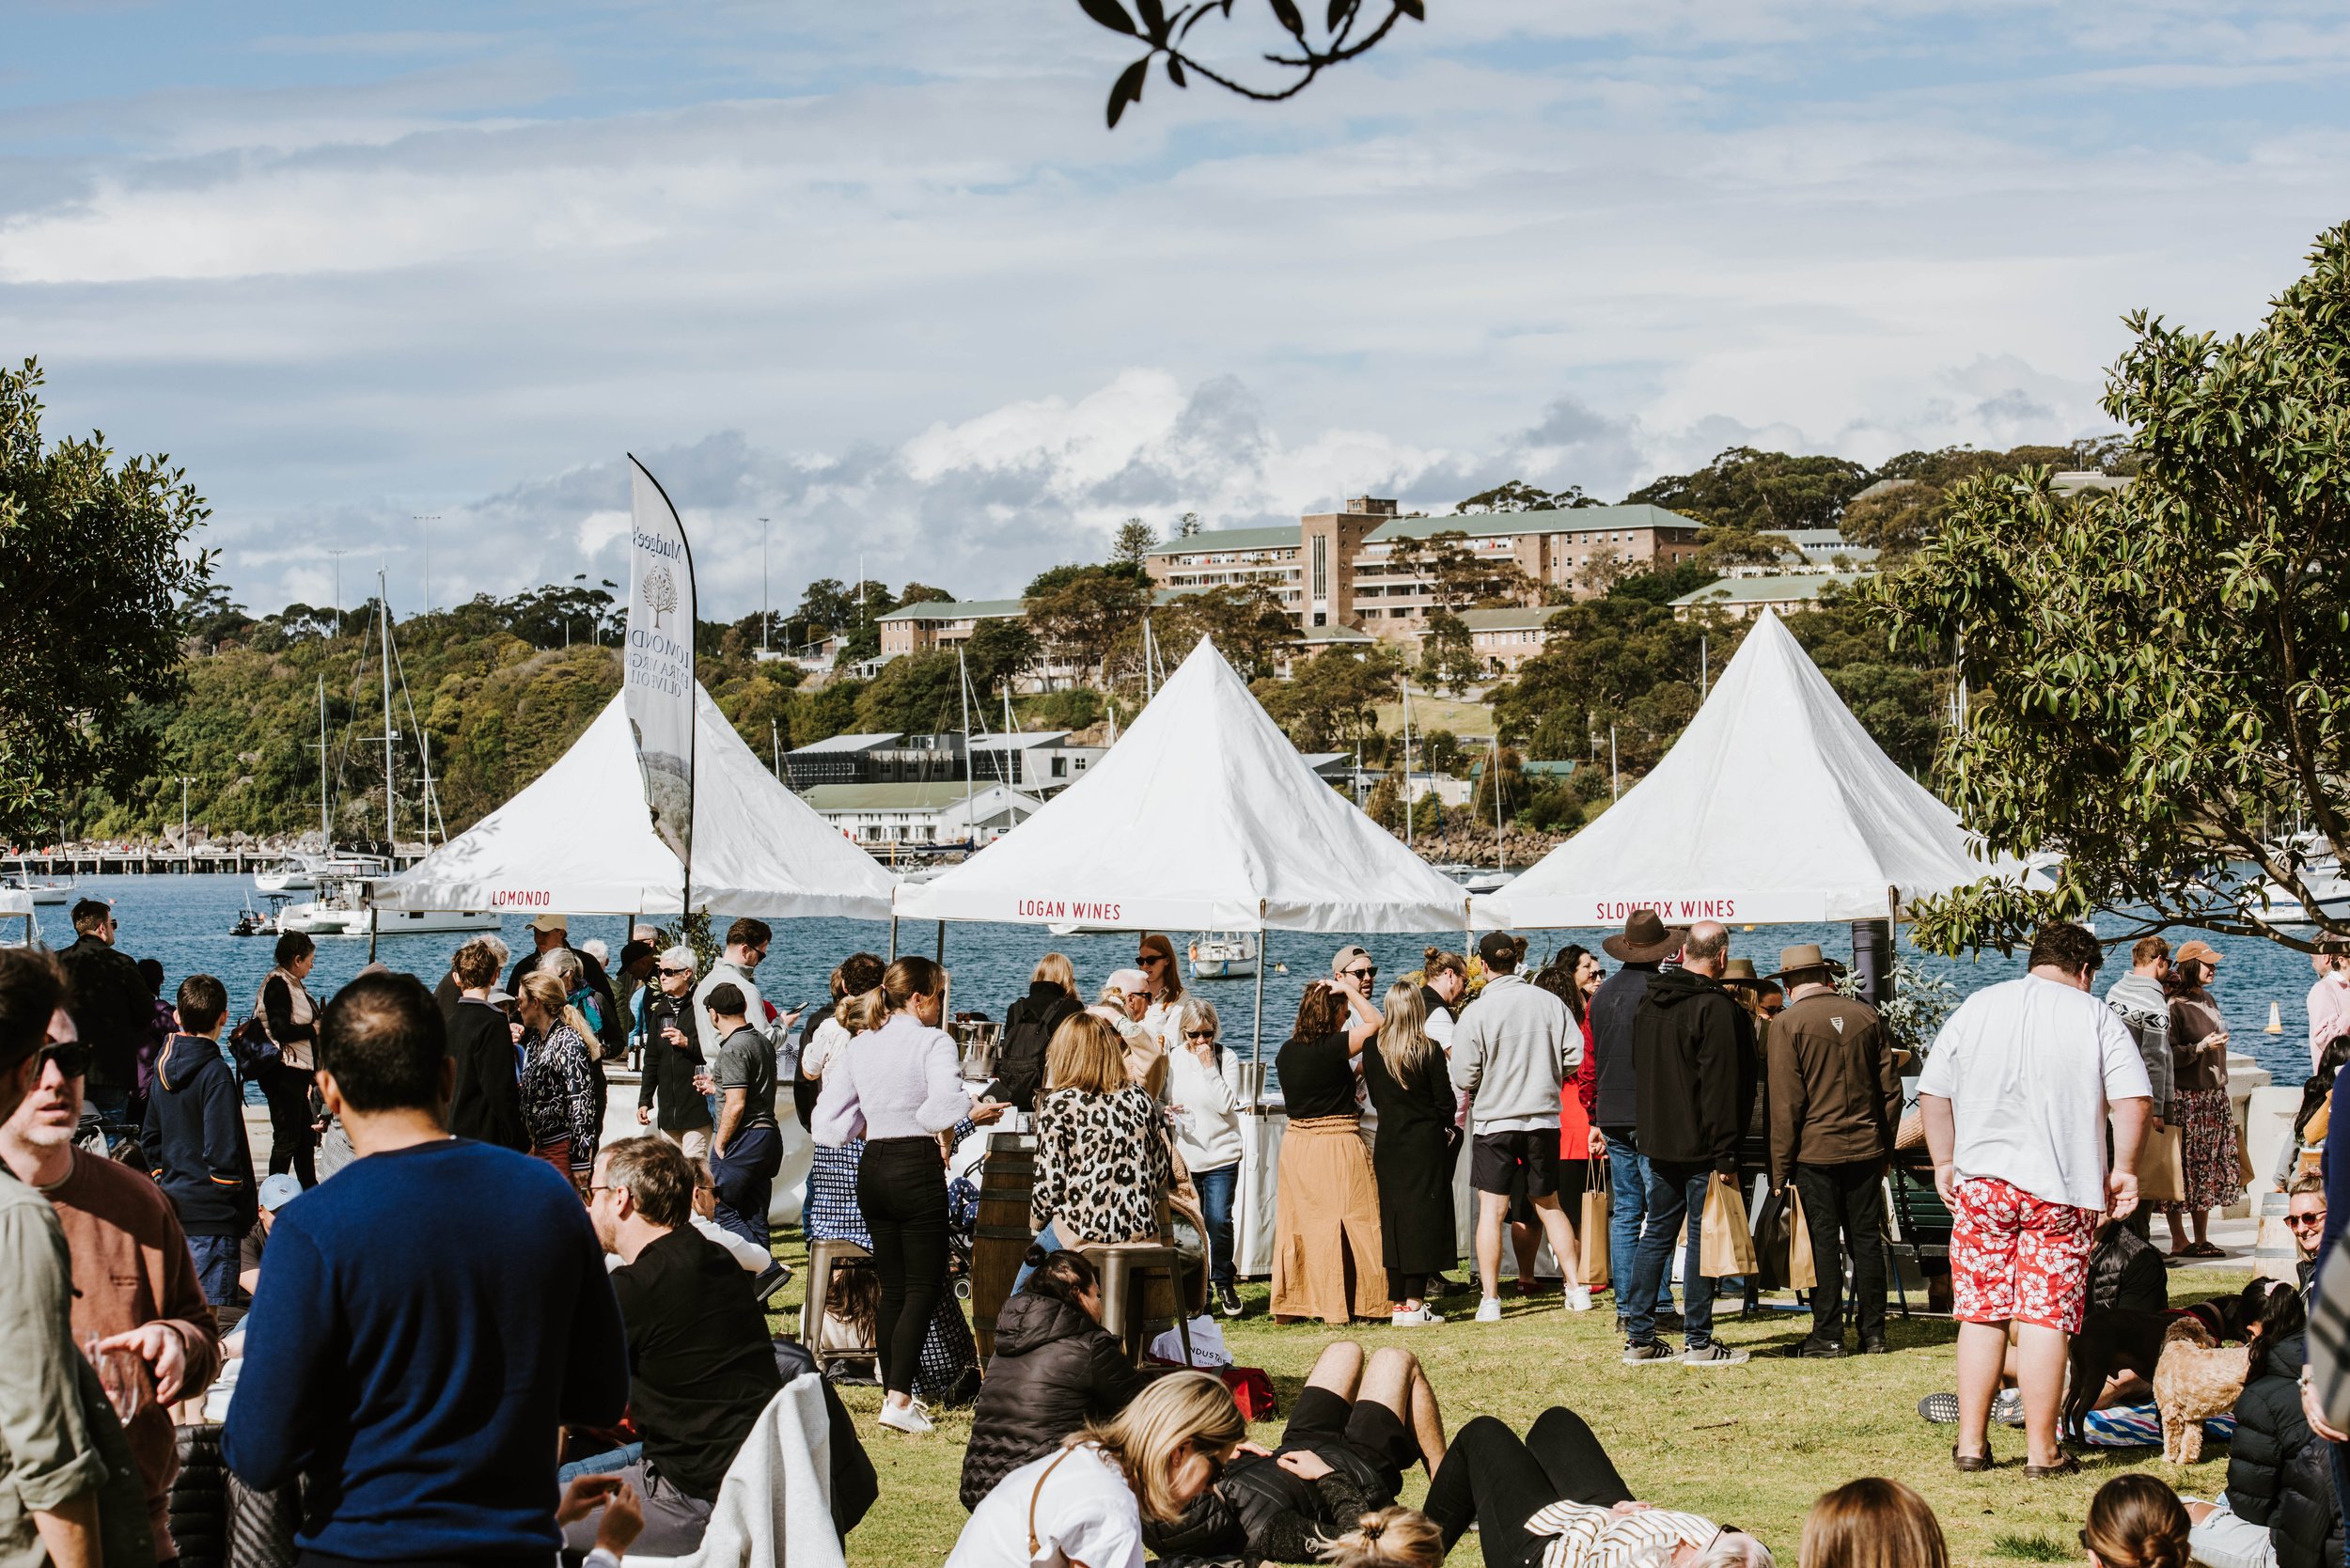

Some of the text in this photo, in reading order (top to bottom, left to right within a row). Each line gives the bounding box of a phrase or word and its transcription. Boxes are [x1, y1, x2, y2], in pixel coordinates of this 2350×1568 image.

[492, 890, 550, 906] LOMONDO
[1018, 900, 1121, 920] LOGAN WINES
[1681, 900, 1735, 918] WINES
